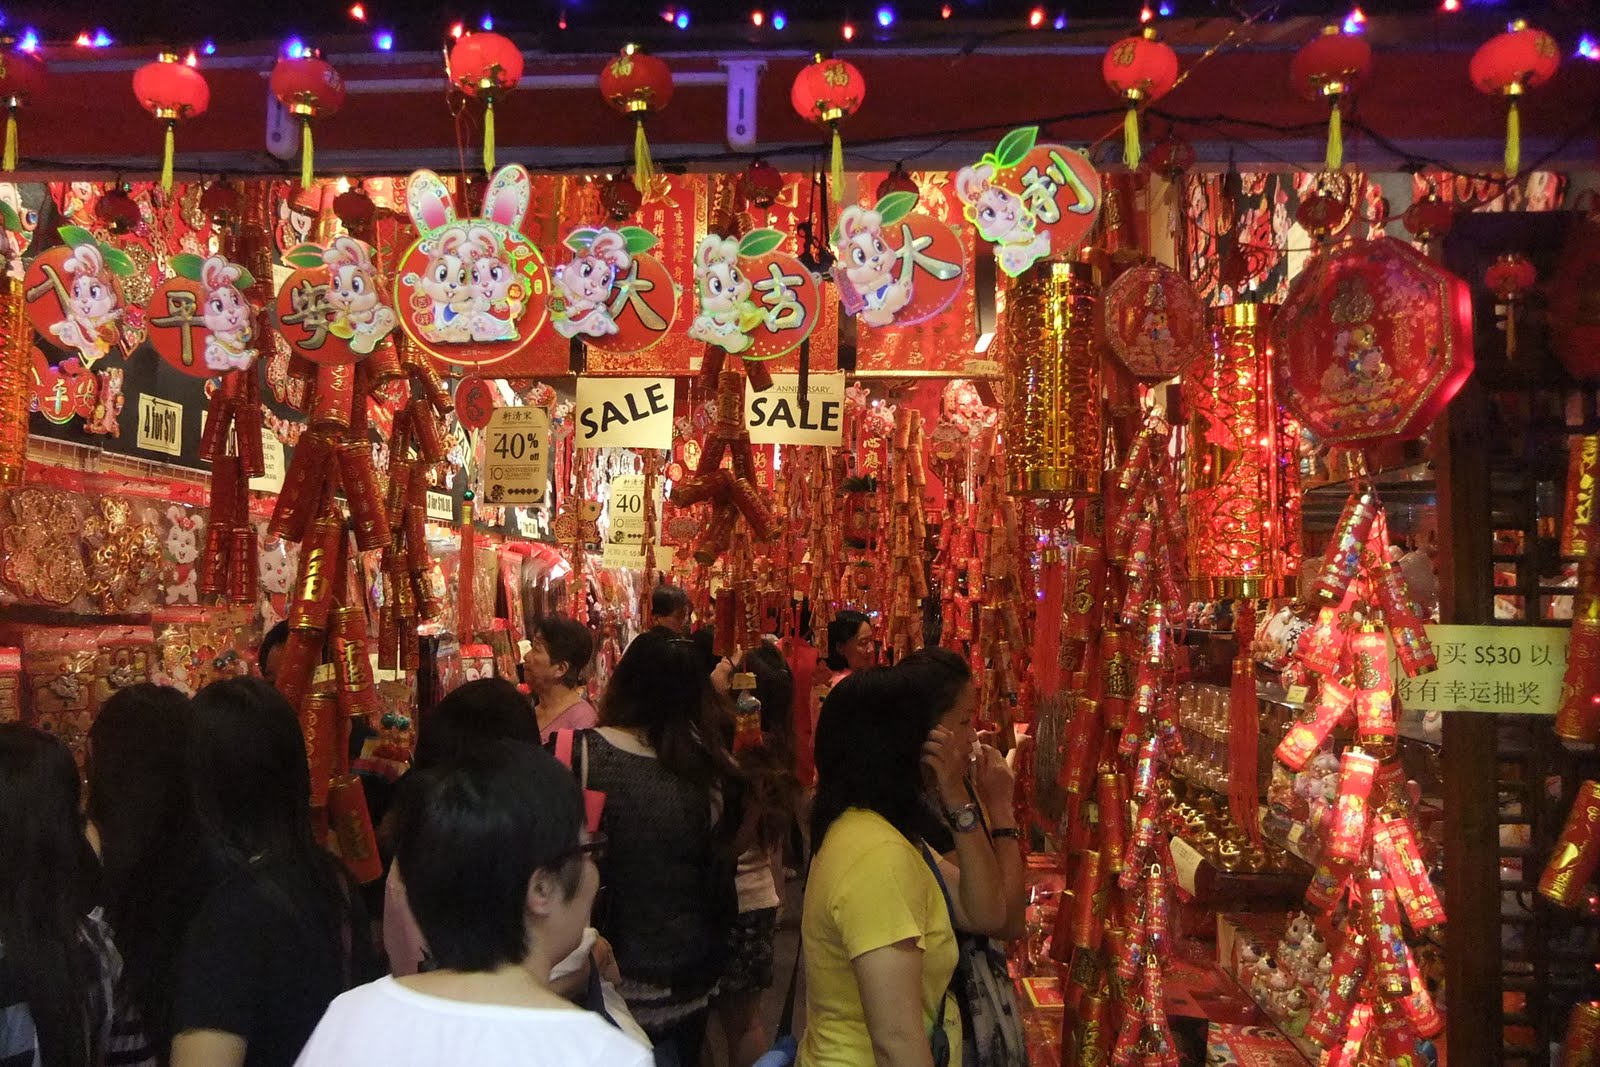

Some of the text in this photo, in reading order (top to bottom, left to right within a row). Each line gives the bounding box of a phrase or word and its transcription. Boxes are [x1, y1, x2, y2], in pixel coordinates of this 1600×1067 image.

[894, 222, 962, 284] 大
[612, 259, 667, 330] 大
[753, 262, 806, 333] 吉
[777, 385, 830, 394] ANNIRSARY
[144, 404, 151, 438] 4
[151, 406, 163, 441] for
[580, 384, 668, 439] SALE
[750, 397, 839, 431] SALE
[616, 494, 641, 513] 40
[1475, 646, 1521, 666] S$30
